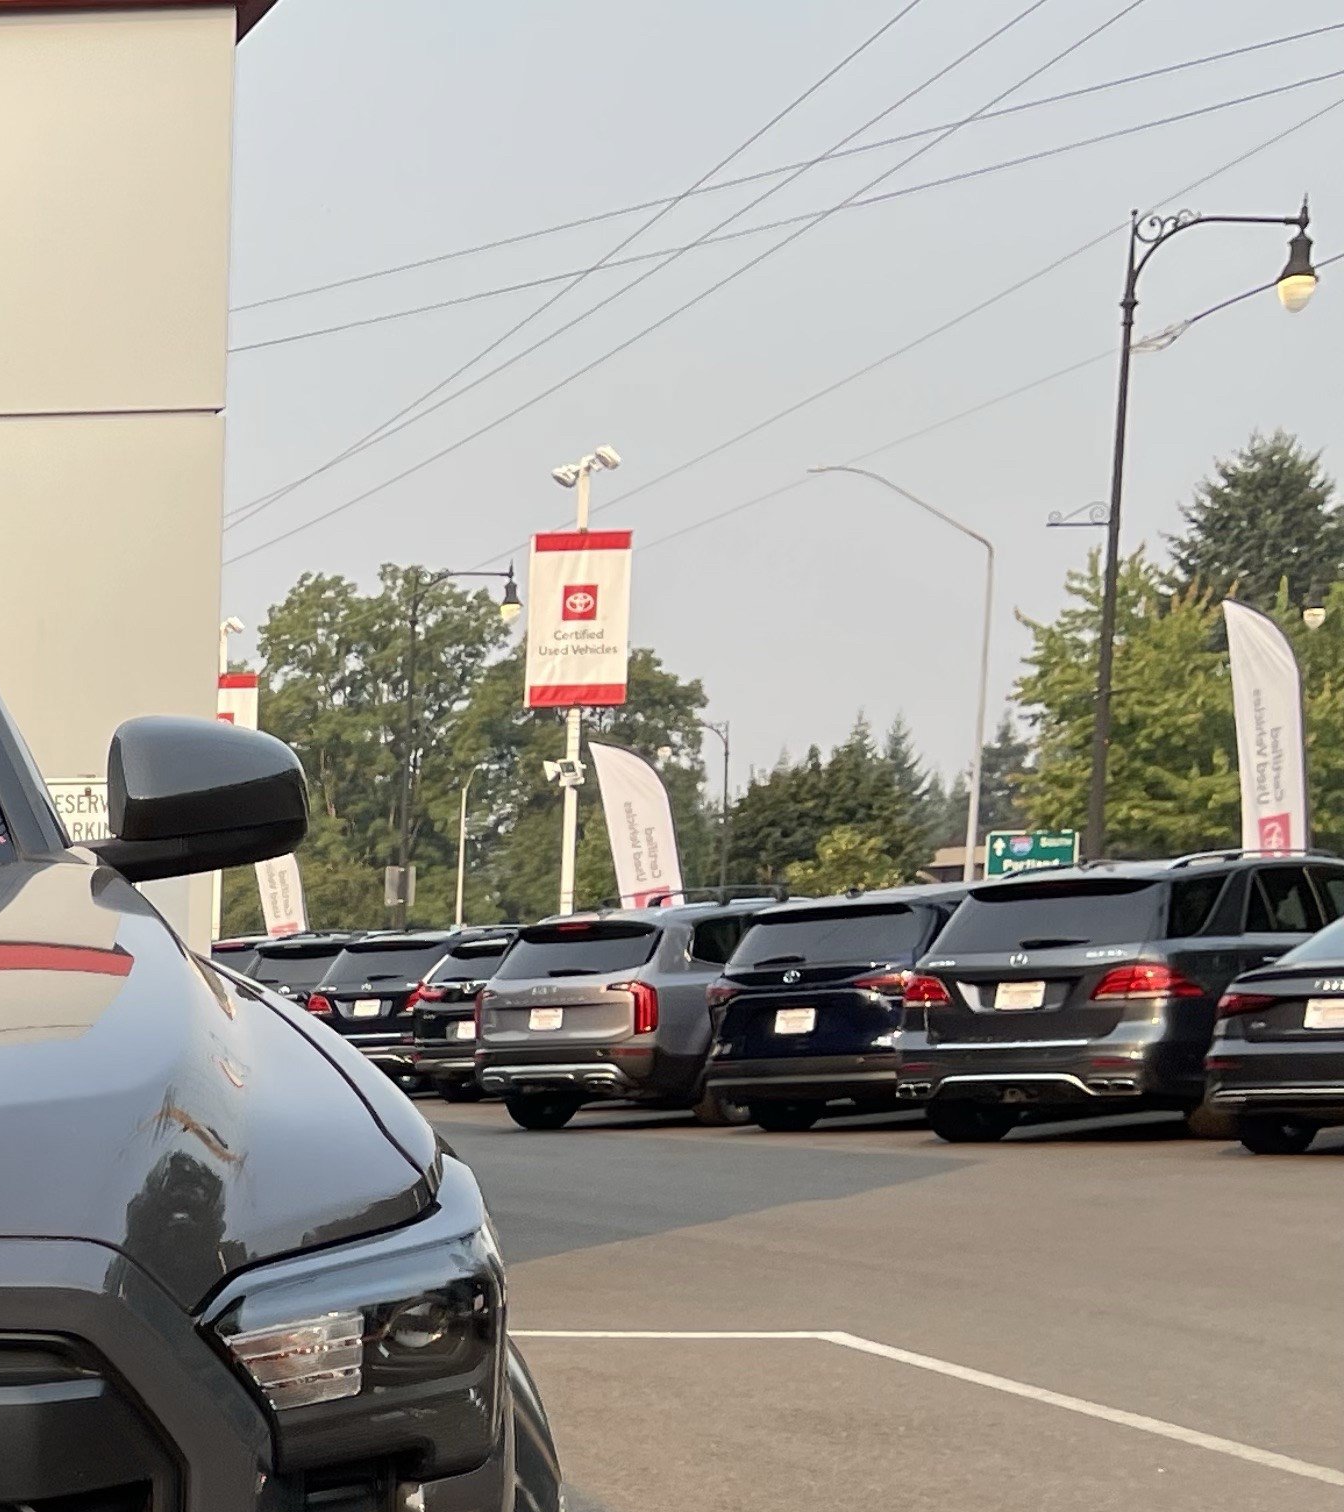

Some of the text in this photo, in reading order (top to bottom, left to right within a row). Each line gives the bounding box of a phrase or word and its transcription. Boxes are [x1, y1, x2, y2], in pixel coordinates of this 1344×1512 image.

[553, 628, 604, 641] Certified
[538, 644, 618, 656] Used Vehicles
[53, 794, 109, 813] ESERV
